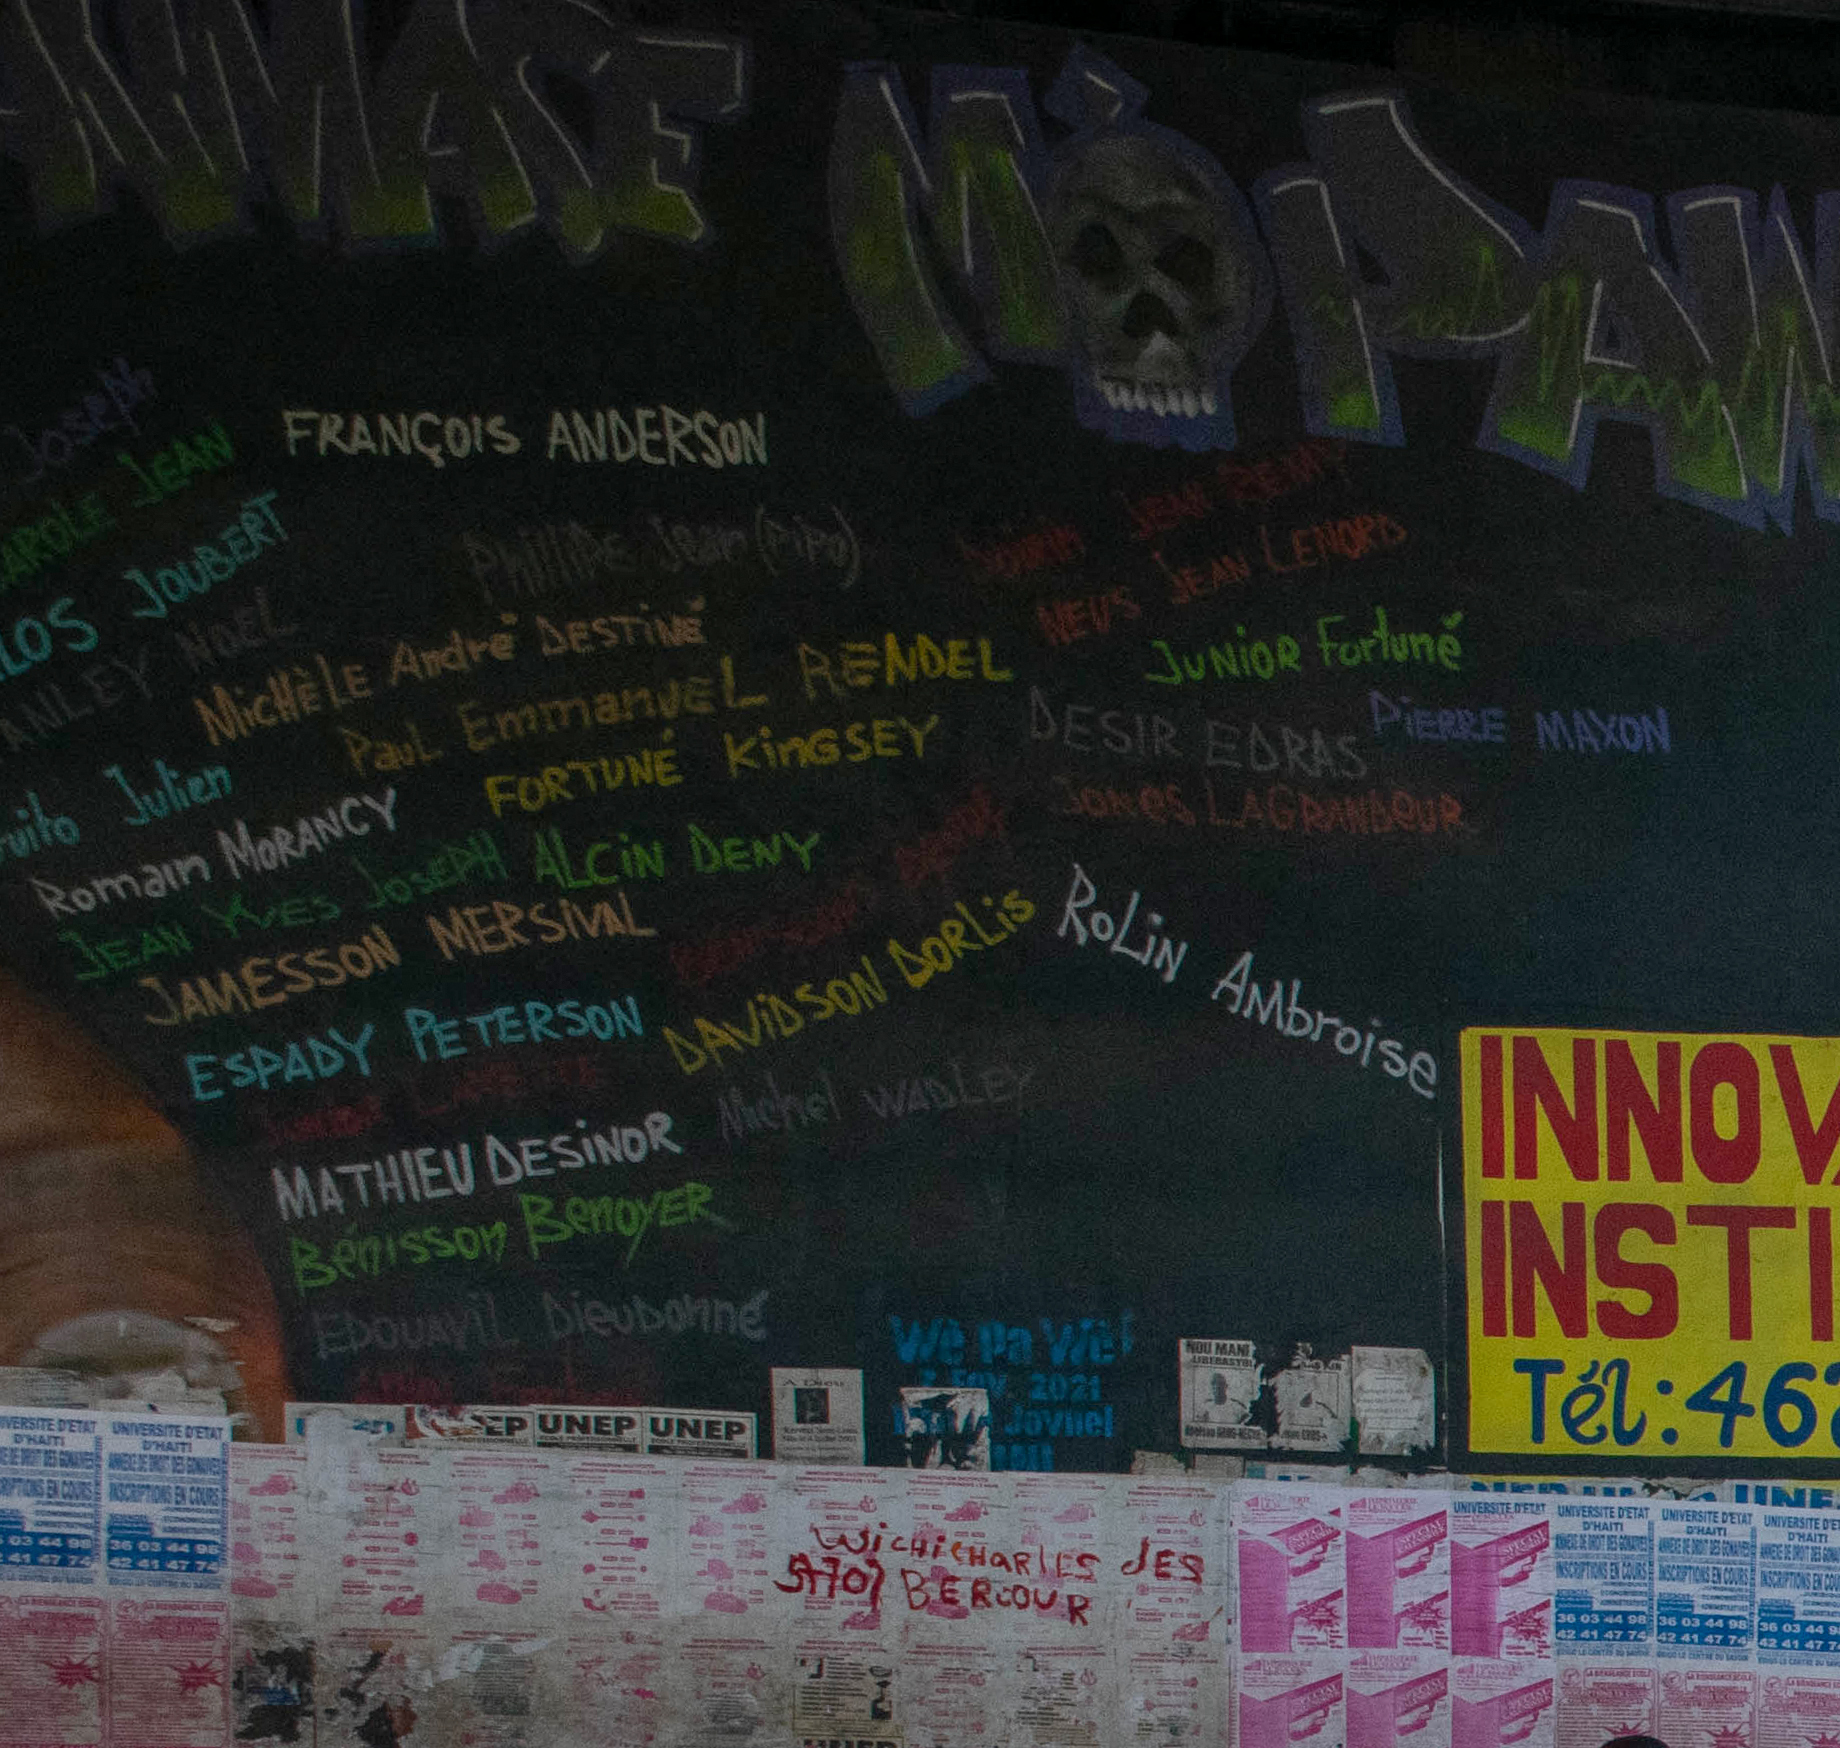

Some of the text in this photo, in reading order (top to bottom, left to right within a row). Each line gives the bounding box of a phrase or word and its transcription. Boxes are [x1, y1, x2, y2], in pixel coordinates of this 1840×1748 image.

[280, 408, 770, 468] FRANÇOIS ANDERSON
[0, 490, 289, 683] LOS JOUBERT
[687, 822, 821, 874] DENY
[138, 923, 401, 1026] JAMESSON
[185, 1023, 376, 1102] ESPADY
[403, 994, 646, 1063] PETERSON
[272, 1139, 476, 1222] MATHIEU
[112, 1421, 224, 1440] UNIVERSITE D'ETAT
[538, 1413, 637, 1437] UNEP
[649, 1416, 747, 1441] UNEP
[1453, 1501, 1547, 1515] UNIVERSITE D'ETAT
[1557, 1505, 1649, 1520] UNIVERSITE D'ETAT
[1662, 1508, 1753, 1525] UNIVERSITE D'ETAT
[1764, 1514, 1821, 1529] UNIVERSITE
[1583, 1520, 1624, 1532] D'HAITI
[1686, 1524, 1727, 1537] D'HAITI
[1787, 1531, 1829, 1544] D'HAITI
[109, 1540, 132, 1551] 36
[167, 1542, 190, 1553] 44
[109, 1557, 132, 1568] 42
[167, 1559, 189, 1570] 47
[900, 1567, 1092, 1626] BERCOUR
[1558, 1613, 1647, 1625] 36 03 44 98
[1659, 1616, 1747, 1630] 36 03 44 98
[1557, 1629, 1647, 1641] 42 41 47 74
[1760, 1622, 1777, 1633] 36
[1783, 1623, 1801, 1634] 03
[1806, 1624, 1824, 1635] 44
[1658, 1632, 1746, 1646] 42 41 47 74
[1760, 1638, 1777, 1649] 42
[1782, 1639, 1800, 1650] 41
[1806, 1640, 1824, 1650] 47
